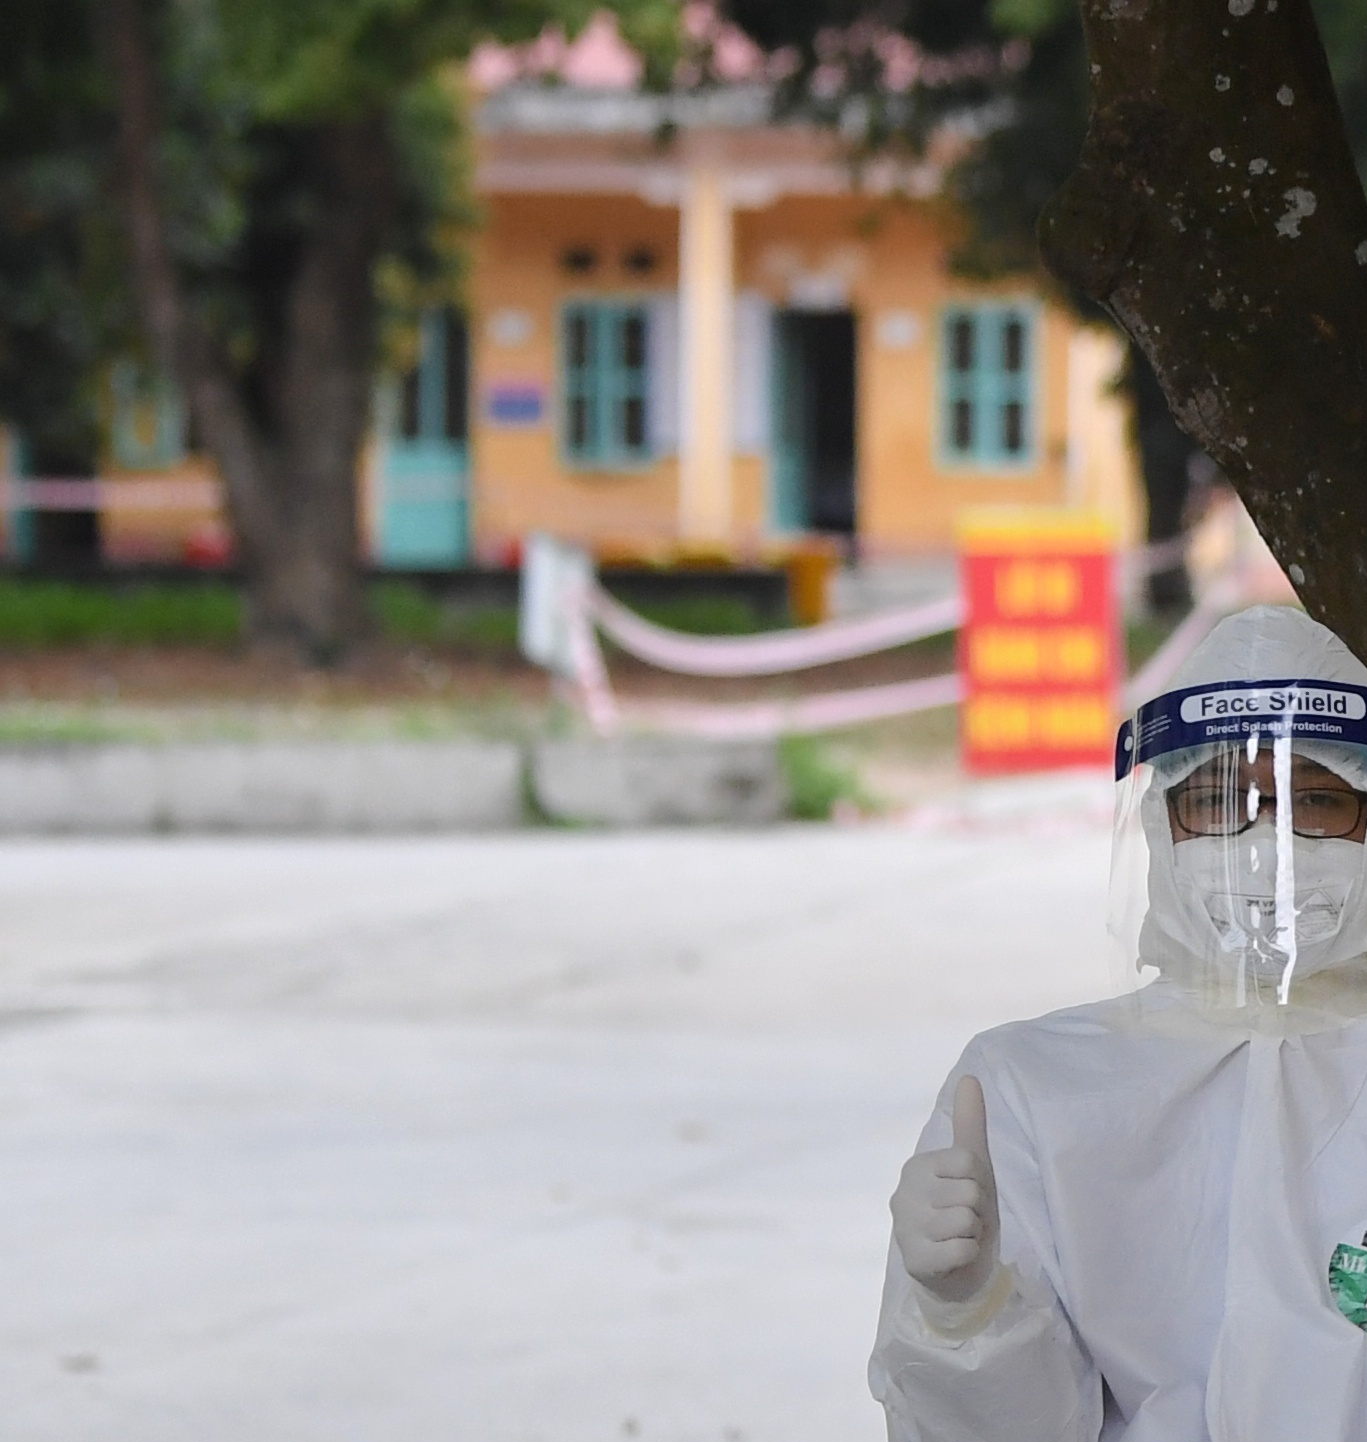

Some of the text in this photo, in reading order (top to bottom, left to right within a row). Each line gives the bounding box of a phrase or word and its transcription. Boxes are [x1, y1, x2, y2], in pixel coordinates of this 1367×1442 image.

[1201, 691, 1347, 717] Face Shield
[1206, 720, 1343, 736] Direct Splash Protection
